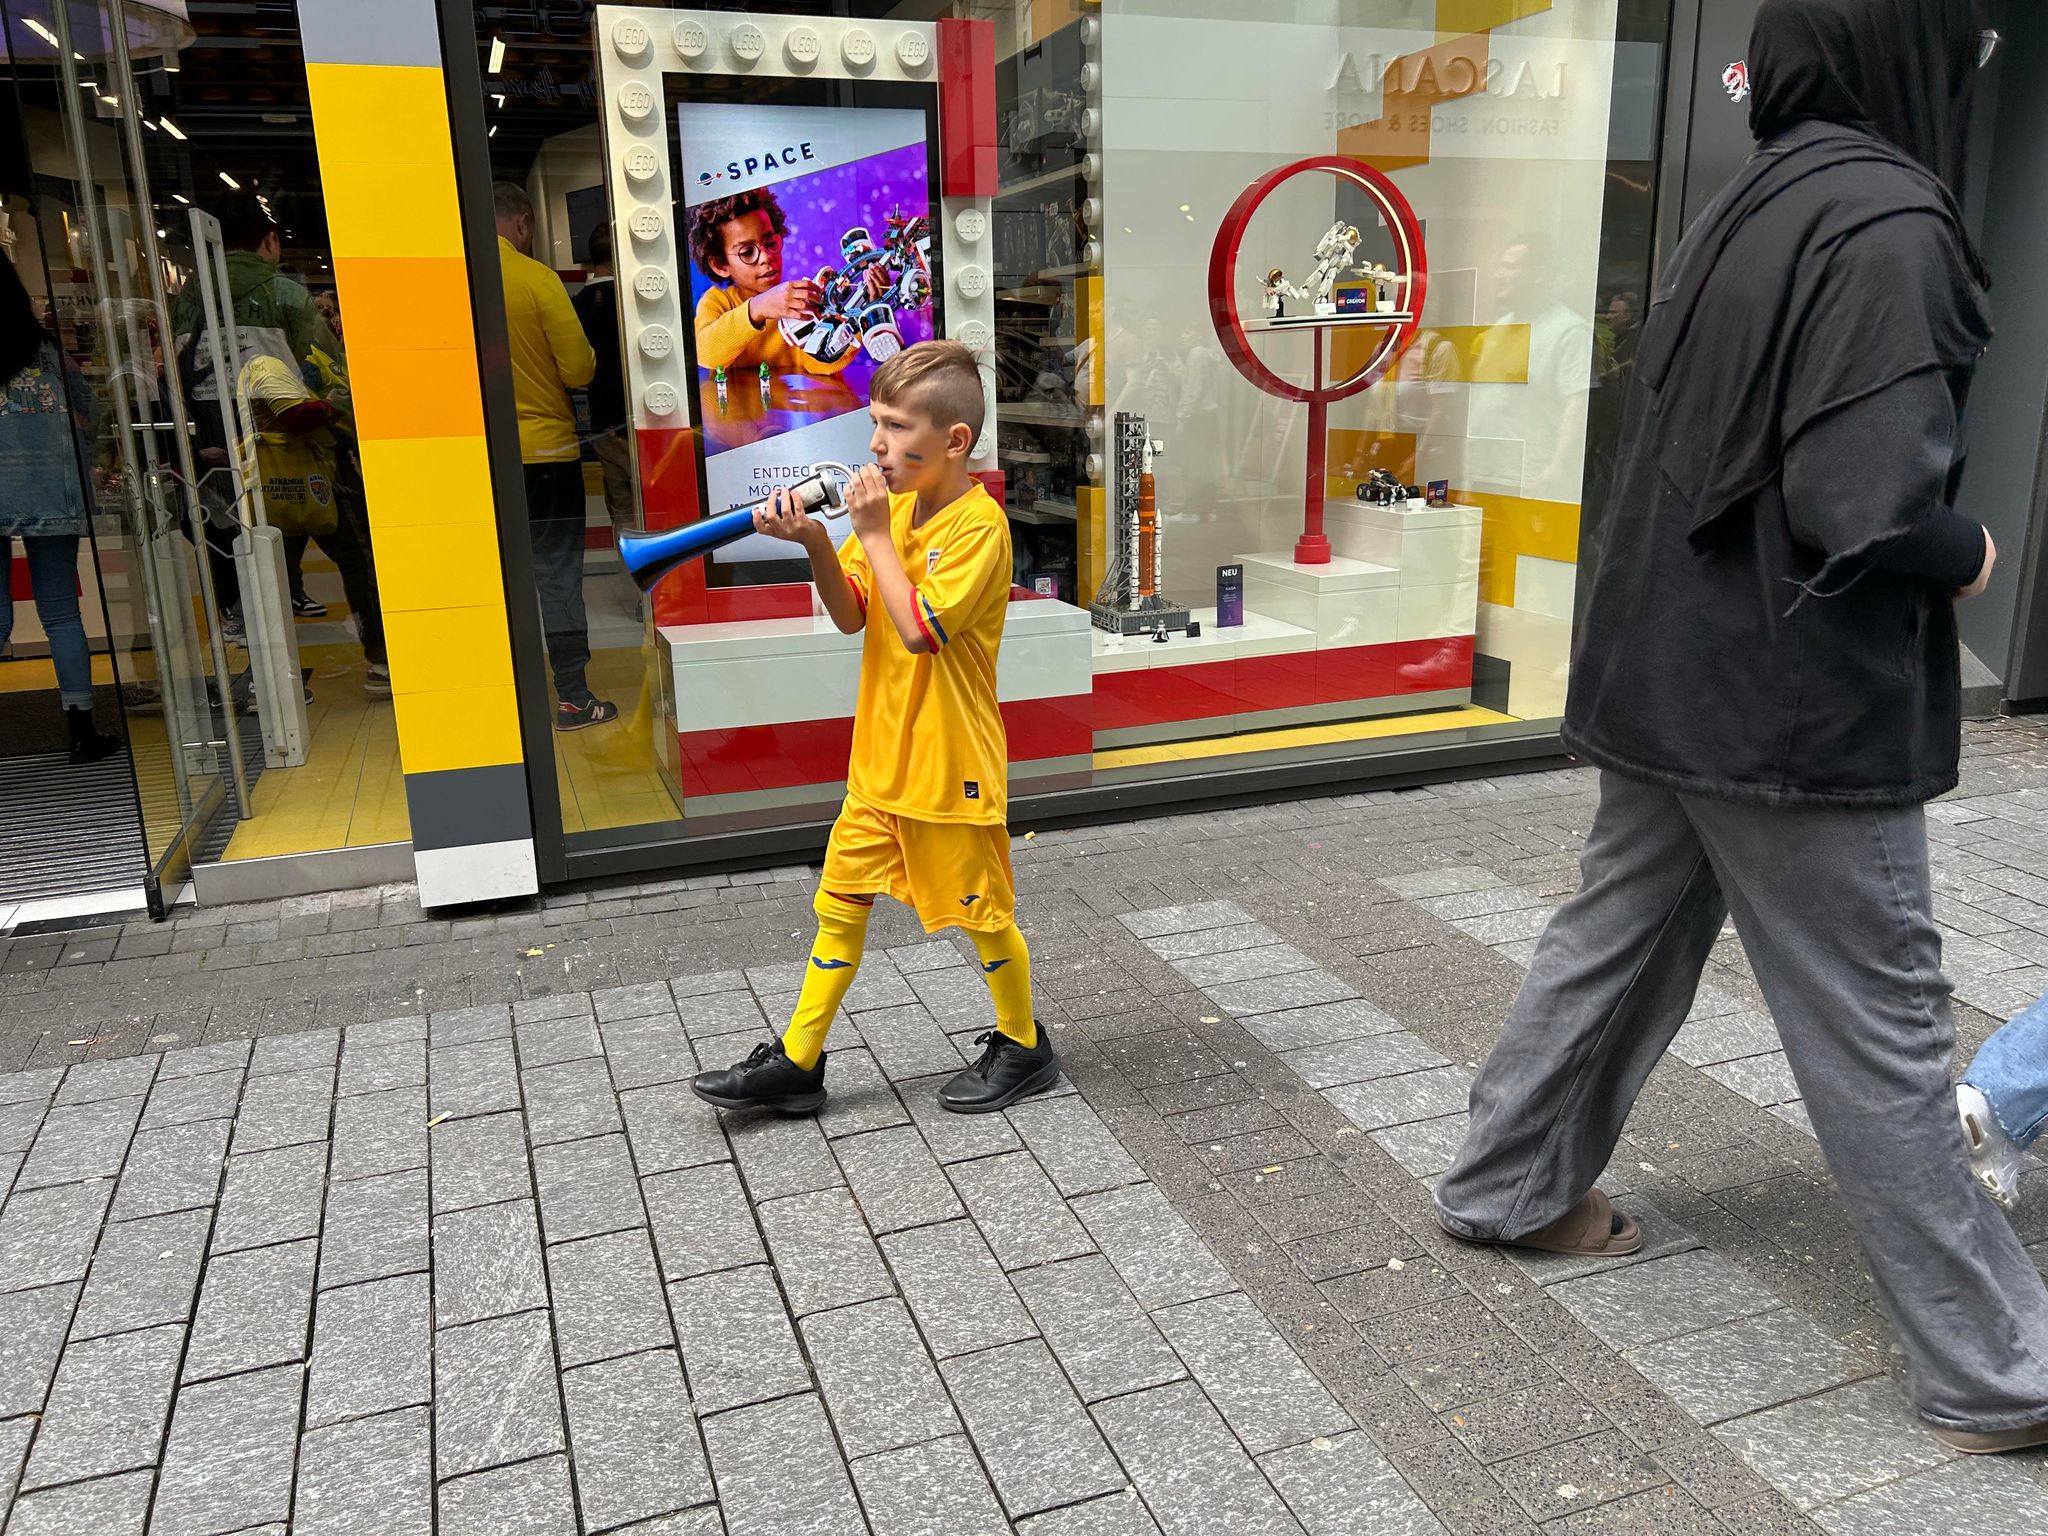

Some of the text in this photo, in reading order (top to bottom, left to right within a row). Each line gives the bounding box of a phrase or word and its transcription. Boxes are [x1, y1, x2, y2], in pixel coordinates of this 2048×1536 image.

[617, 28, 646, 46] LEGO
[677, 31, 704, 48] LEGO
[735, 34, 761, 51] LEGO
[791, 37, 817, 54] LEGO
[847, 40, 873, 56] LEGO
[901, 41, 926, 58] LEGO
[623, 92, 650, 109] LEGO
[628, 155, 655, 172] LEGO
[726, 142, 815, 181] SPACE
[633, 216, 660, 233] LEGO
[959, 218, 984, 234] LEGO
[638, 276, 665, 292] LEGO
[961, 274, 985, 290] LEGO
[643, 335, 670, 351] LEGO
[649, 392, 674, 409] LEGO
[753, 466, 810, 479] ENTDEC
[1222, 568, 1238, 577] NEU
